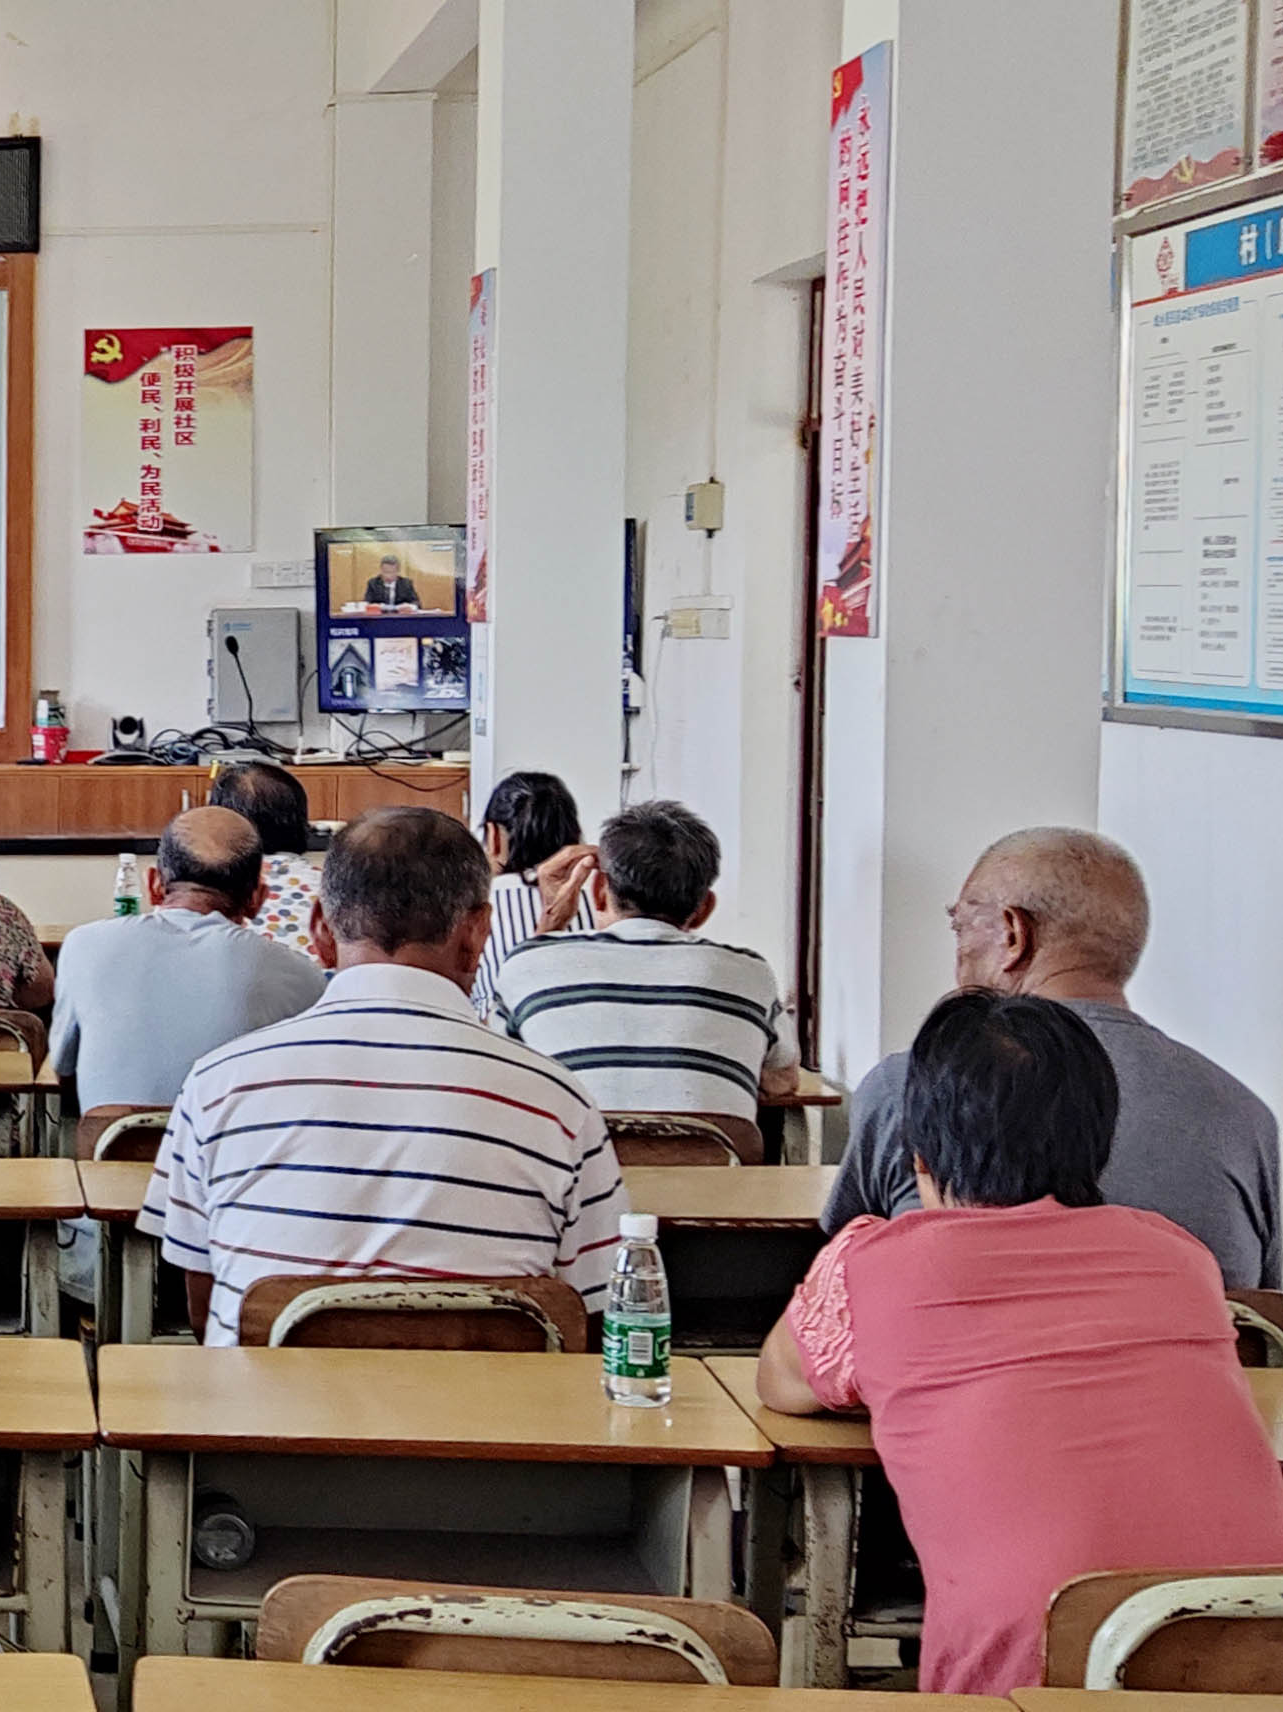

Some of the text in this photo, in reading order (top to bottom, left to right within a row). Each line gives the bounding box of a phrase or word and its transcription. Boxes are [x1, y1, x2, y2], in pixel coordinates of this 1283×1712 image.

[139, 372, 162, 529] 便民、利民、为民活动
[174, 346, 196, 446] 积极开展社区
